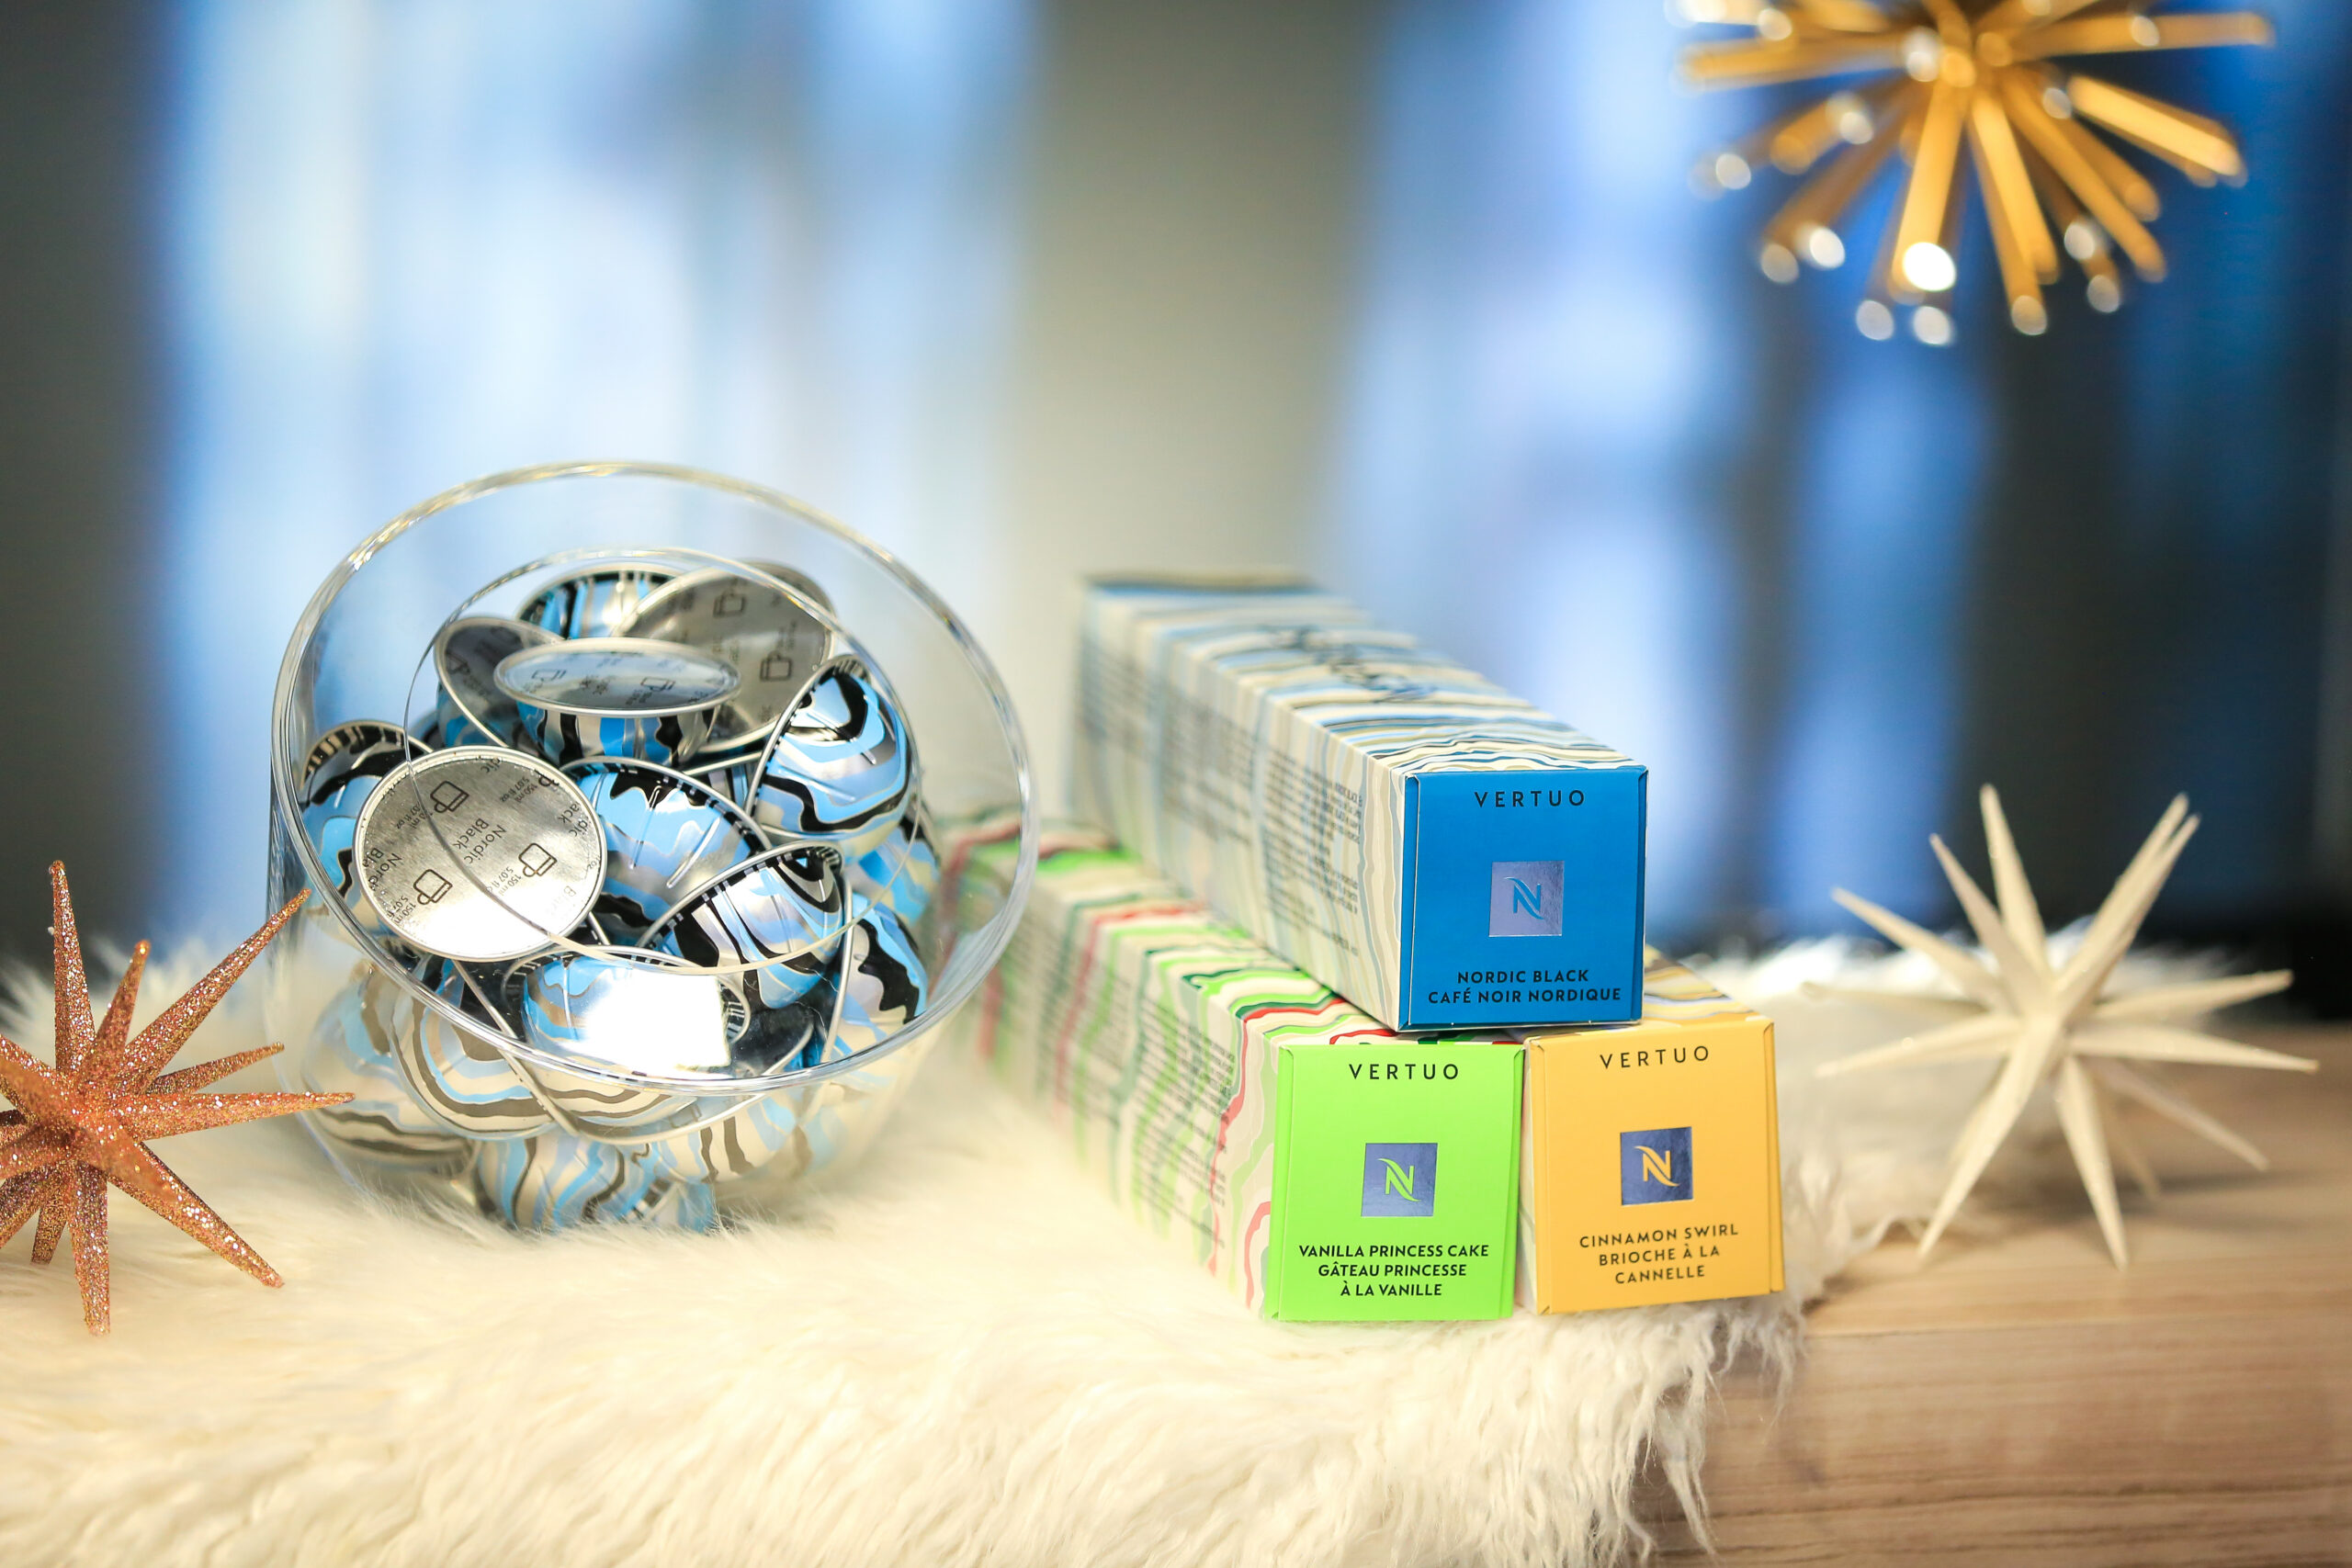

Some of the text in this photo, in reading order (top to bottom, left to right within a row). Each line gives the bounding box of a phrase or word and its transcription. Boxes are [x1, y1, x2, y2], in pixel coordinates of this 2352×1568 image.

[1475, 790, 1584, 807] VERTUO
[450, 817, 490, 848] Black
[462, 823, 507, 863] Nordic
[497, 866, 514, 883] 5.07
[505, 873, 522, 887] 150
[497, 884, 508, 897] ml
[401, 901, 416, 917] 150
[1458, 970, 1588, 983] NORDIC BLACK
[1429, 987, 1620, 1003] CAFÉ NOIR NORDIQUE
[1600, 1046, 1709, 1068] VERTUO
[1349, 1064, 1458, 1079] VERTUO
[1580, 1224, 1738, 1247] CINNAMON SWIRL
[1299, 1246, 1488, 1257] VANILLA PRINCESS CAKE
[1600, 1244, 1719, 1266] BRIOCHE À LA
[1318, 1261, 1466, 1276] GÂTEAU PRINCESSE
[1615, 1266, 1704, 1283] CANNELLE
[1340, 1280, 1442, 1295] À LA VANILLE
